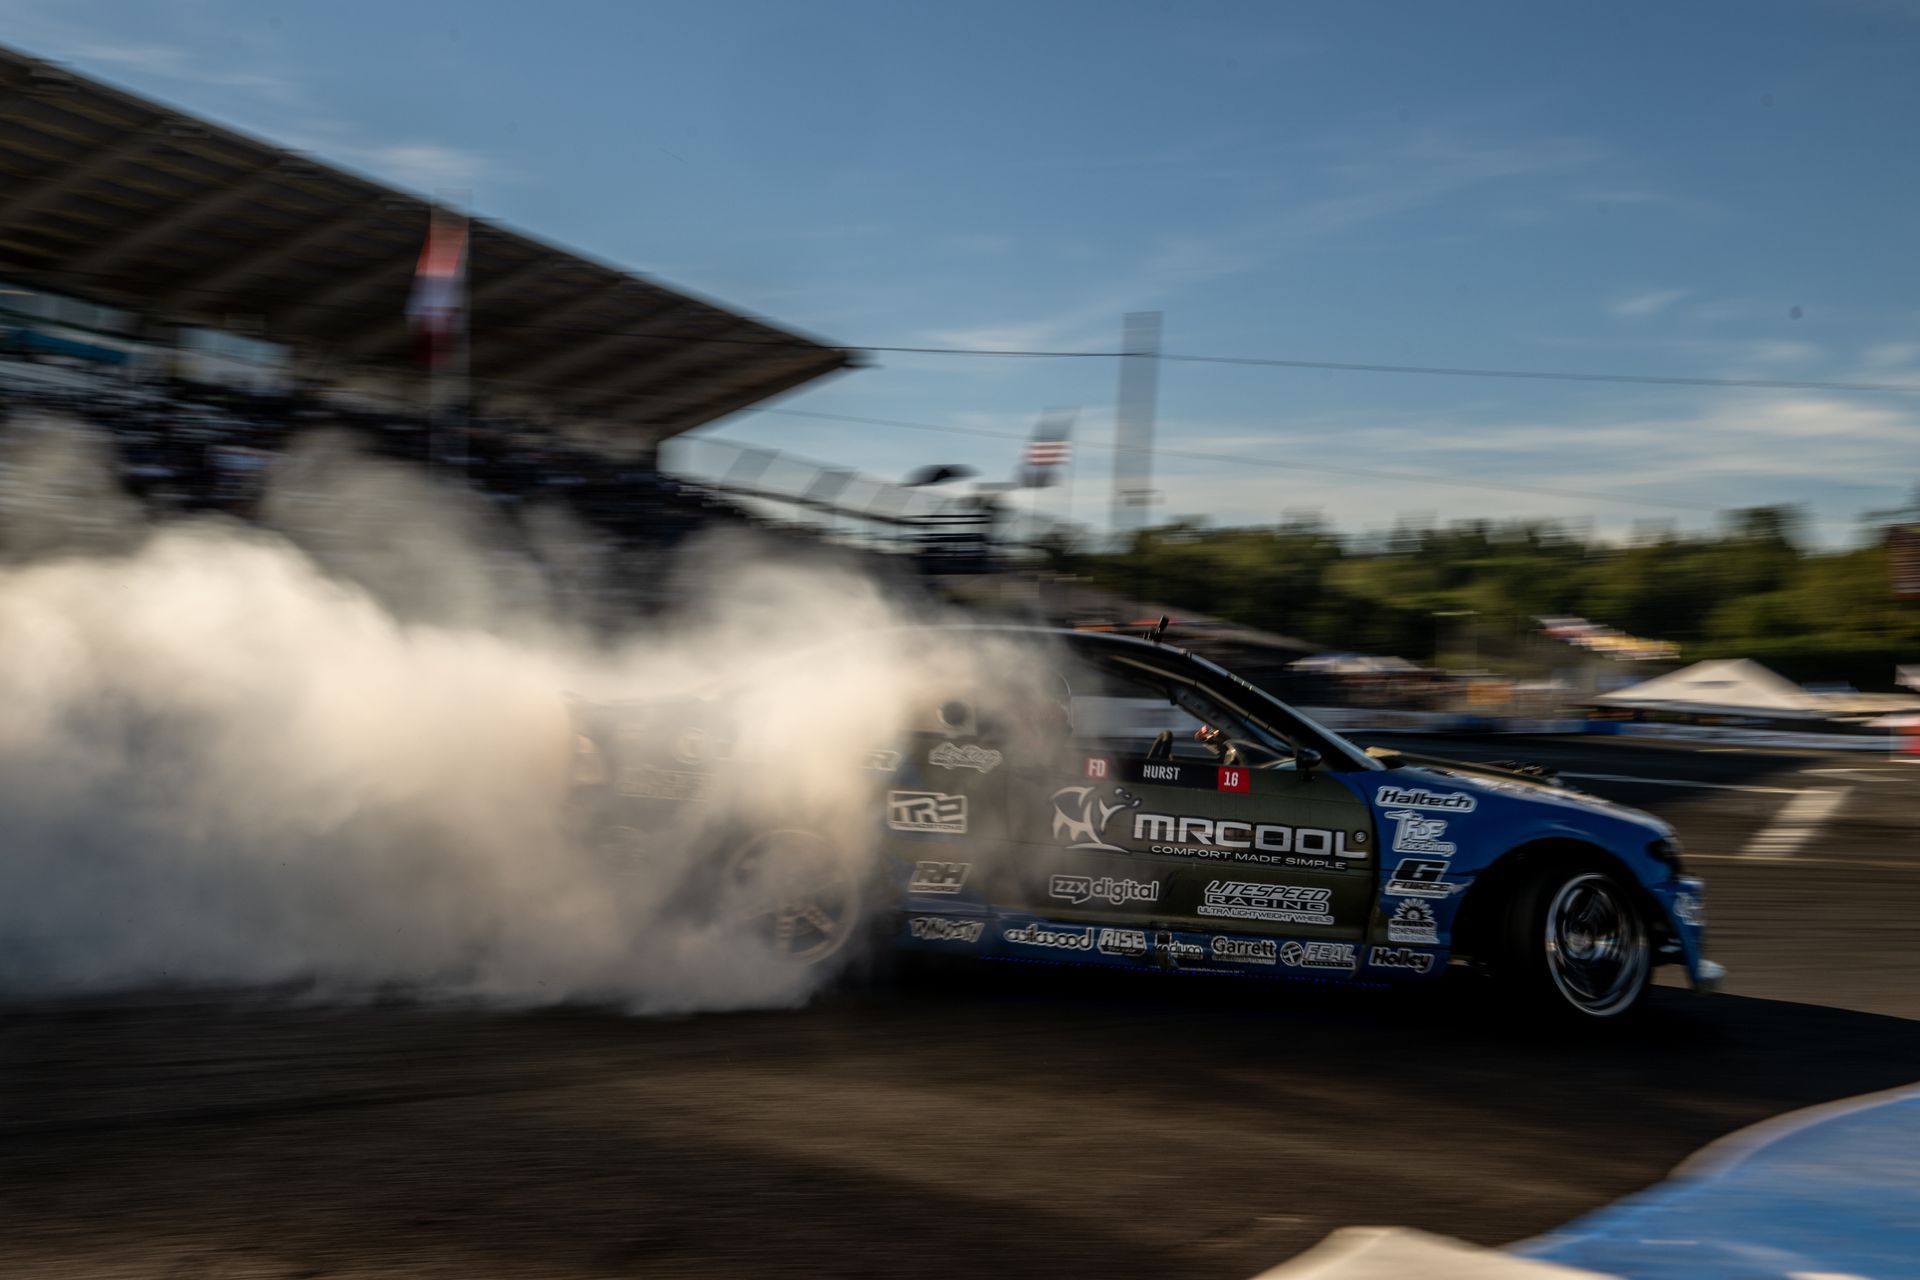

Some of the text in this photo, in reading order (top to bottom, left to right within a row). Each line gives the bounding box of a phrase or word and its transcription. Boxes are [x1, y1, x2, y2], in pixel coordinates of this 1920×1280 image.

[1087, 760, 1240, 788] FD HURST 16
[1380, 789, 1472, 809] Haltech
[1150, 844, 1348, 870] COMFORT MADE SIMPLE
[1206, 881, 1331, 902] LITESPEED
[1208, 894, 1328, 912] RACING
[1198, 907, 1230, 917] ULTRA
[1294, 914, 1334, 924] WHEELS
[1006, 924, 1093, 950] wilwood
[1100, 929, 1146, 949] RISE
[1211, 935, 1276, 957] Garrett
[1304, 942, 1357, 961] FEAL
[1373, 947, 1431, 973] Holley
